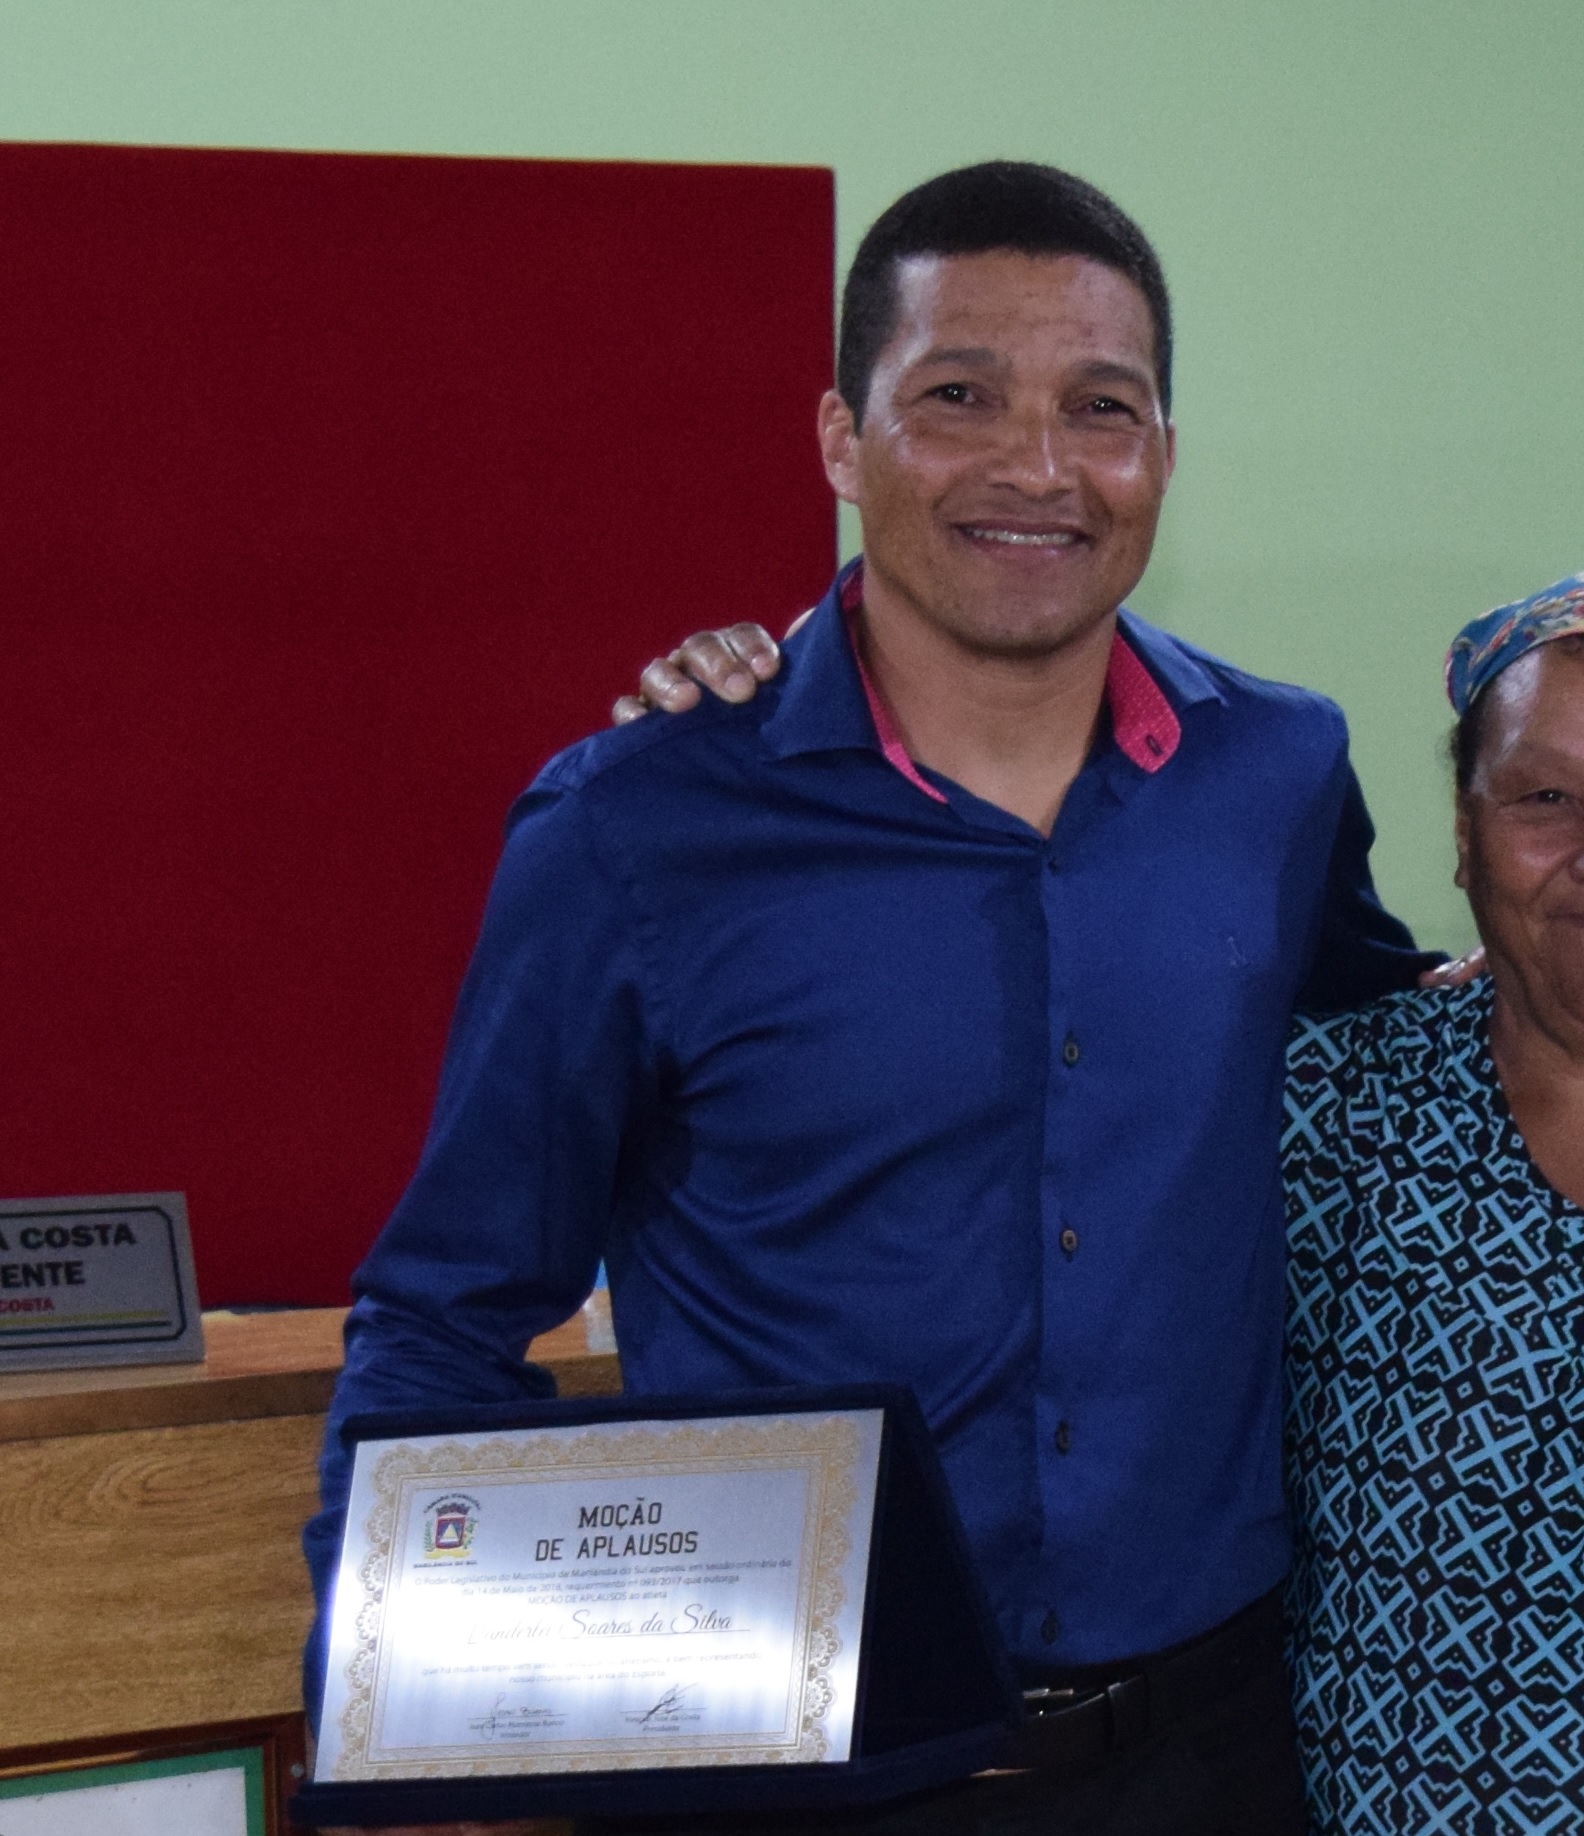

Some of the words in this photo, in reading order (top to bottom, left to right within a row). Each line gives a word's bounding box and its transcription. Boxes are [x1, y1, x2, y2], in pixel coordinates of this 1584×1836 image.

[20, 1223, 136, 1250] COSTA
[1, 1261, 85, 1288] ENTE
[577, 1497, 663, 1531] MOÇÃO
[535, 1538, 565, 1561] DE
[577, 1530, 699, 1560] APLAUSOS
[640, 1611, 664, 1633] da
[670, 1603, 733, 1634] Silva
